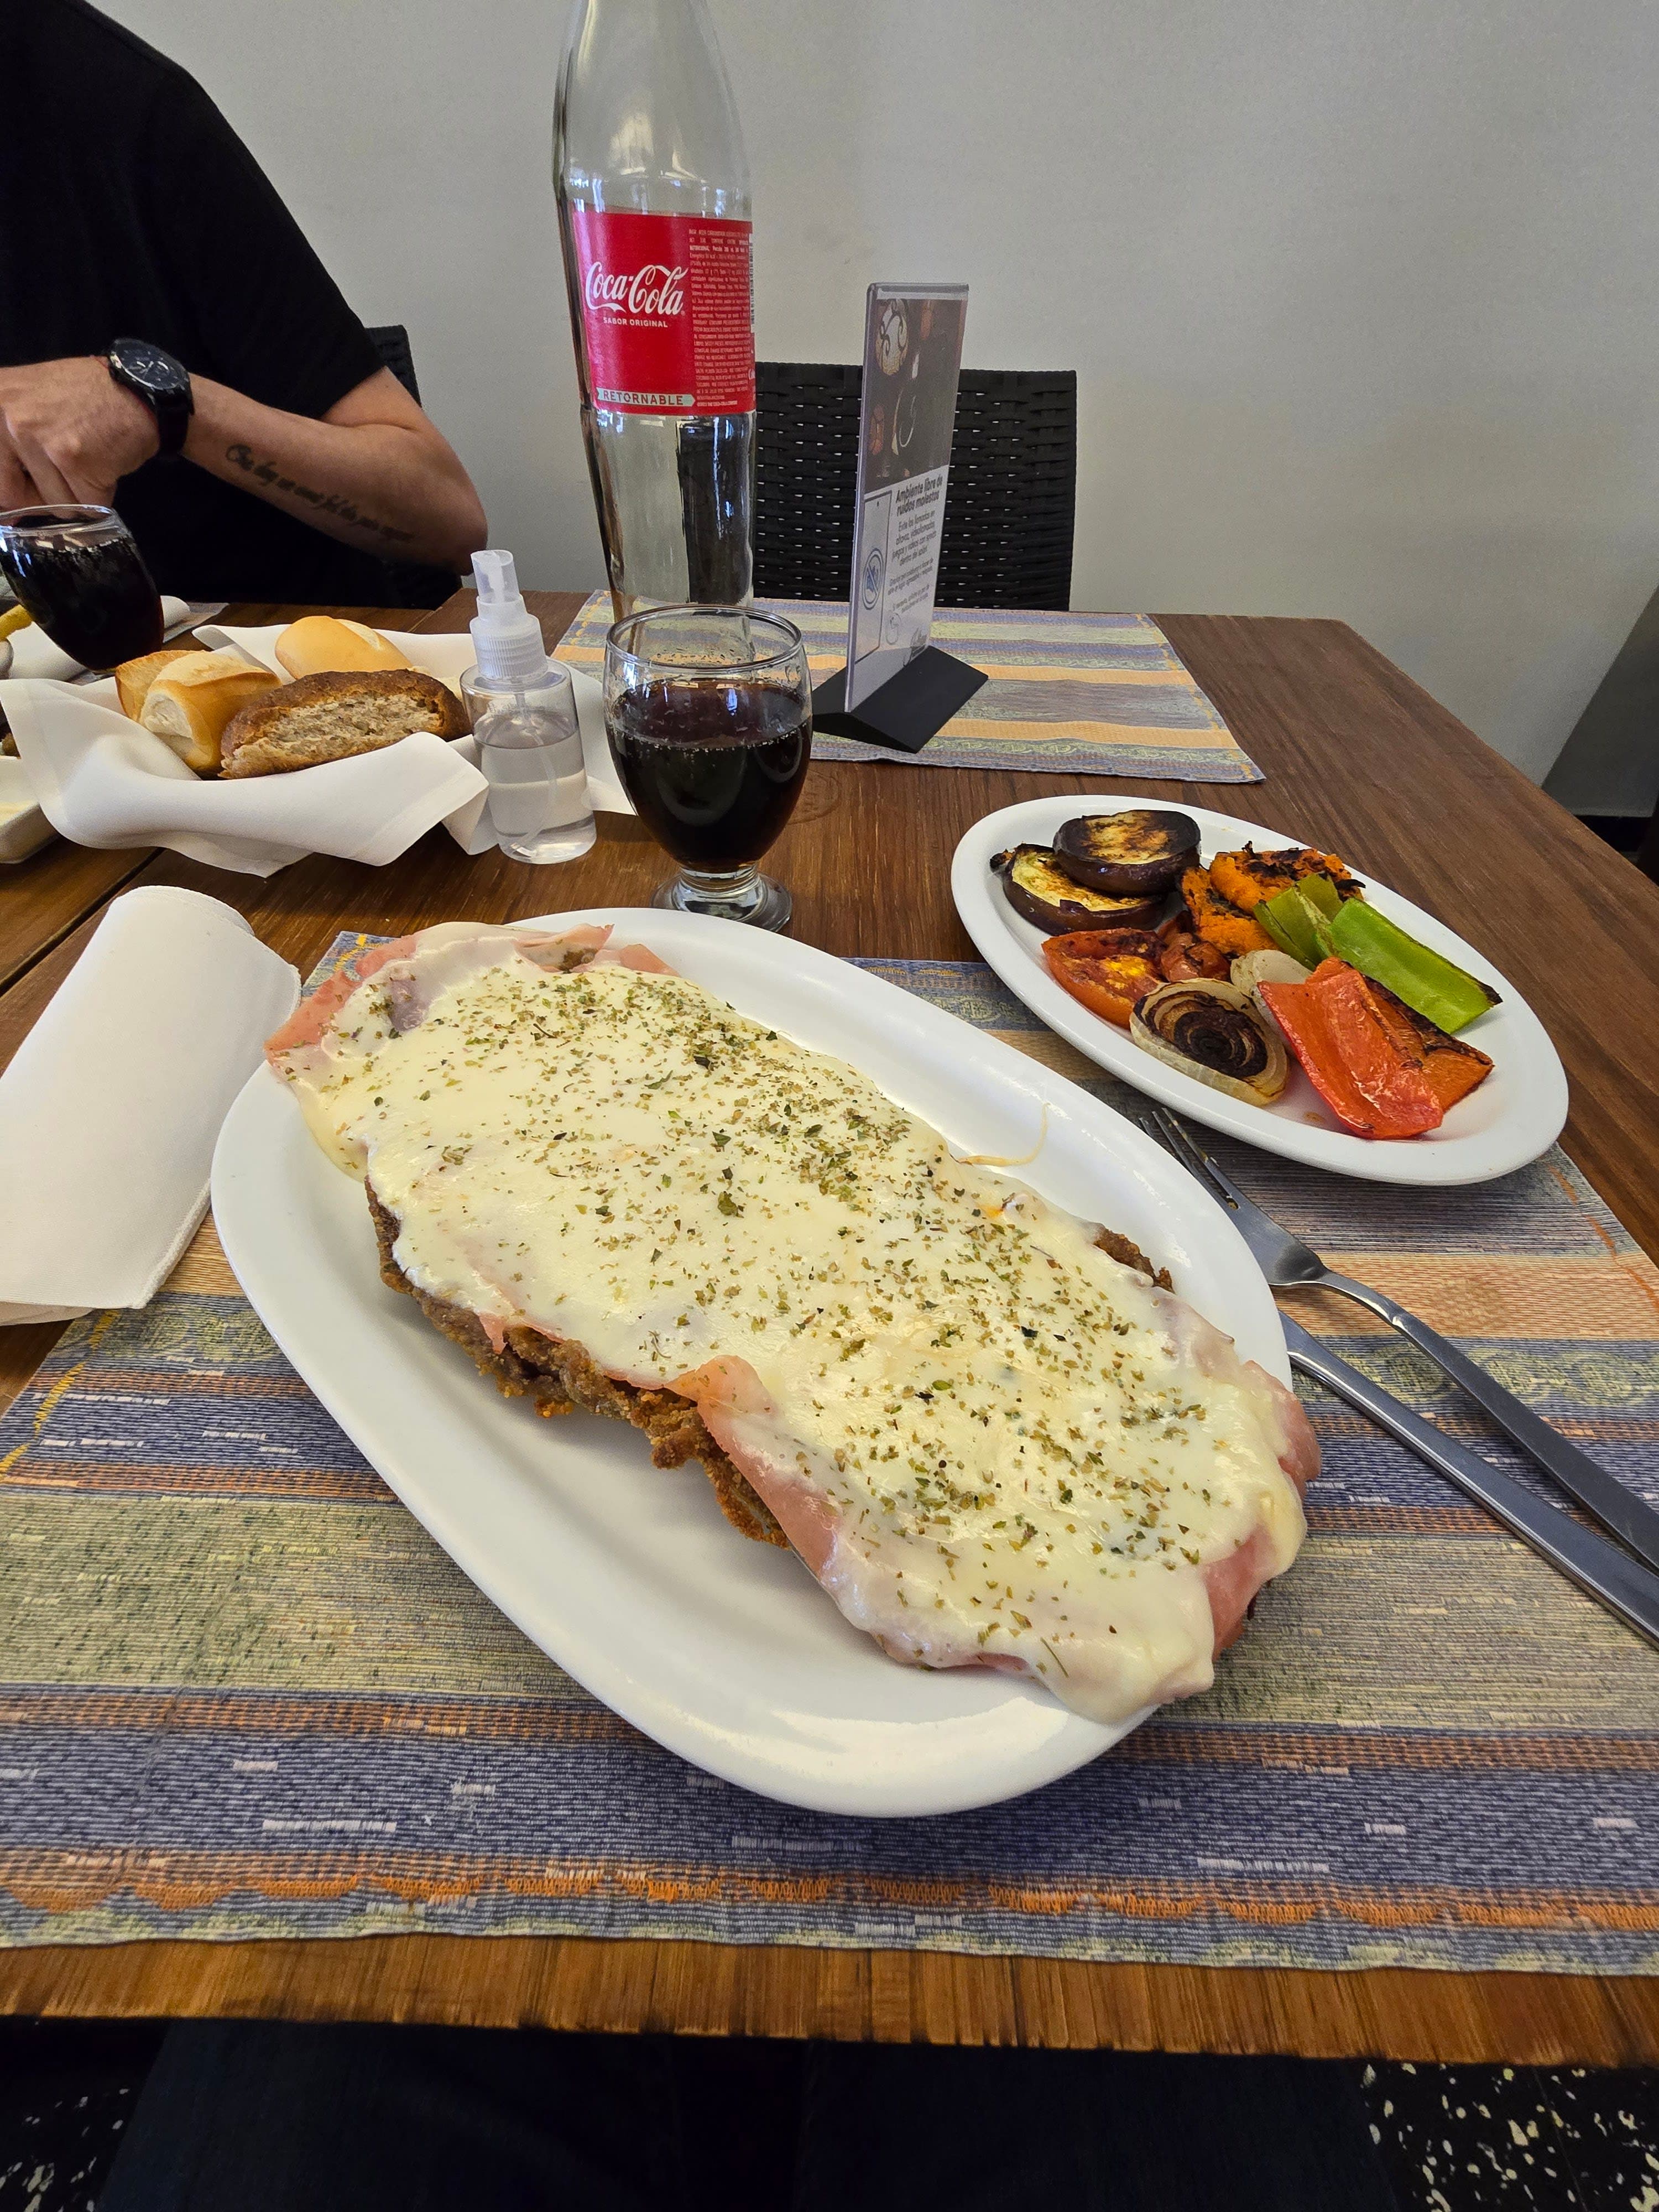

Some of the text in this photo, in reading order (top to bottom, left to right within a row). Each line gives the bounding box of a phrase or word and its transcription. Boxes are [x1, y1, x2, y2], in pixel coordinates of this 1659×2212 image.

[586, 262, 688, 315] Coca-Cola
[603, 317, 668, 328] SABOR ORIGINAL
[603, 389, 684, 406] RETORNABLE
[896, 473, 943, 503] Ambiente libre de
[897, 490, 940, 517] ruidos molestos
